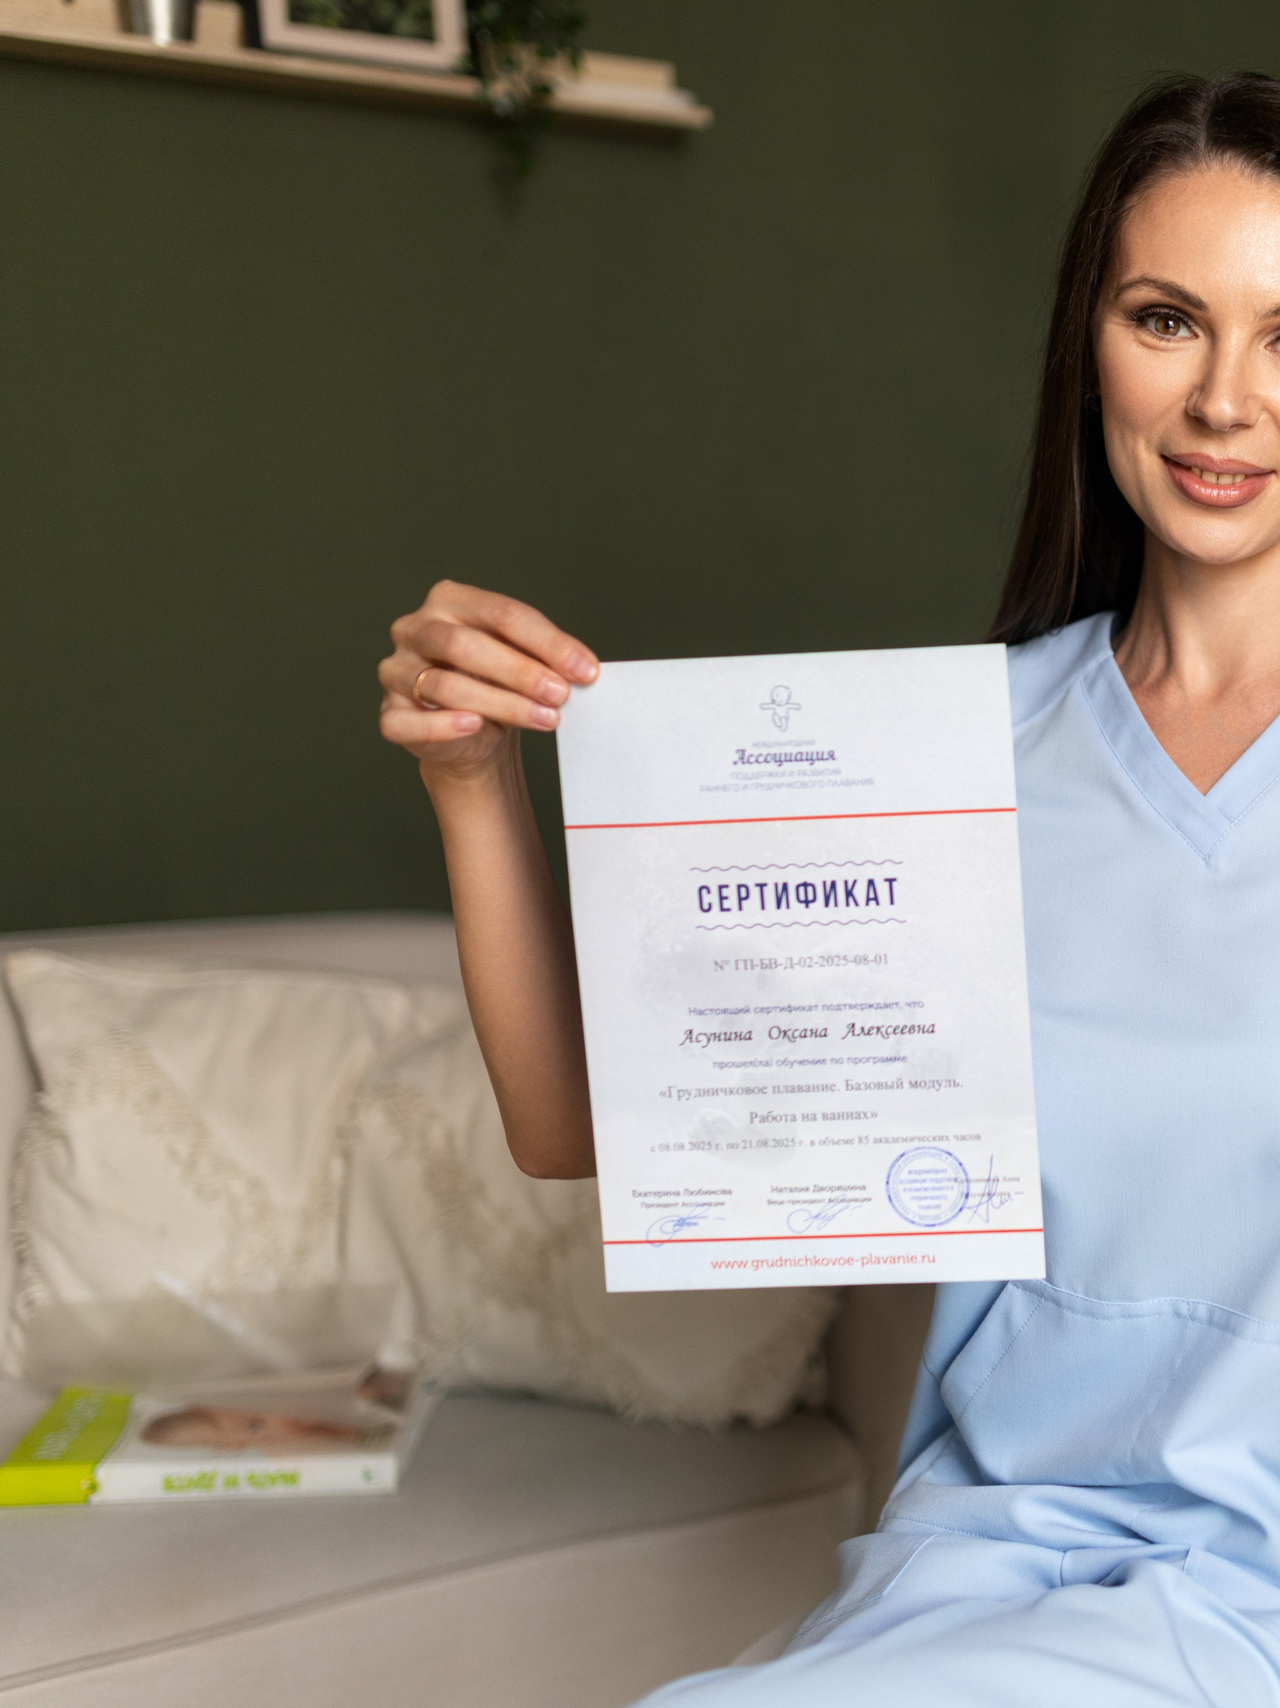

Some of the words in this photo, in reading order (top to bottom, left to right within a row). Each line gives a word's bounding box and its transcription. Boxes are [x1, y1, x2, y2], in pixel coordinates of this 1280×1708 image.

[732, 748, 837, 767] Ассоциация
[730, 770, 786, 780] ПОДДЕРЖКИ
[796, 768, 842, 778] РАЗВИТИЯ
[699, 783, 739, 793] РАННЕГО
[750, 780, 825, 792] ГРУДНИЧКОВОГО
[827, 778, 876, 788] ПЛАВАНИЯ
[697, 877, 899, 913] СЕРТИФИКАТ
[733, 952, 889, 971] ГП-БВ-Д-02-2025-08-01
[688, 1005, 750, 1016] Настоящий
[753, 1003, 818, 1015] сертификат
[821, 1001, 903, 1013] подтверждает,
[905, 1000, 924, 1009] что
[678, 1028, 753, 1049] Асунина
[767, 1025, 829, 1043] Оксана
[840, 1021, 936, 1040] Алексеевна
[712, 1058, 774, 1070] прошел(ла)
[775, 1056, 827, 1069] обучение
[829, 1056, 845, 1065] по
[846, 1054, 908, 1066] программе
[658, 1084, 768, 1102] «Грудничковое
[771, 1081, 841, 1096] плавание.
[844, 1077, 905, 1092] Базовый
[908, 1077, 964, 1092] модуль.
[748, 1110, 798, 1125] Работа
[800, 1112, 818, 1123] на
[821, 1109, 879, 1122] ваннах»
[726, 1142, 740, 1151] по
[817, 1136, 855, 1147] объеме
[857, 1135, 870, 1145] 85
[872, 1134, 950, 1145] академических
[952, 1132, 982, 1143] часов
[631, 1189, 681, 1199] Екатерина
[770, 1185, 810, 1194] Наталия
[640, 1201, 680, 1210] Президент
[710, 1252, 937, 1271] www.grudnichkovoe-plavanie.ru
